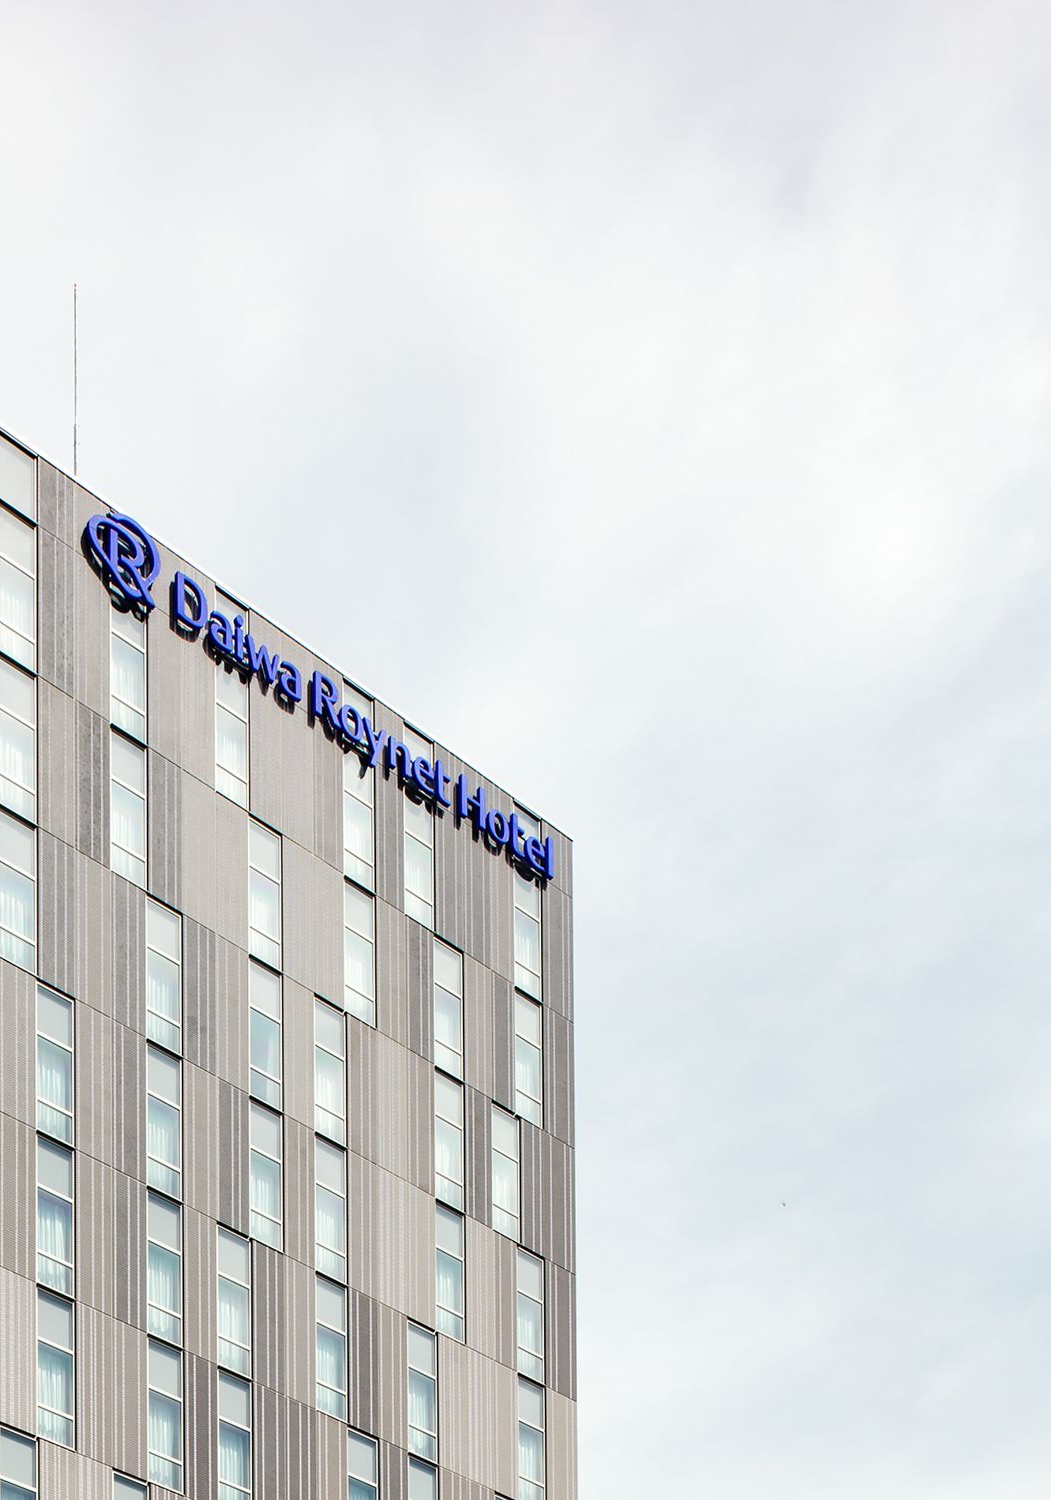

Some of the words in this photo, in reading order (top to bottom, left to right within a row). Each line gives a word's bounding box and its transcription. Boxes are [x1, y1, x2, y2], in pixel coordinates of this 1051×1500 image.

[173, 570, 303, 703] Daiwa
[312, 669, 451, 808] Roynet
[458, 772, 556, 881] Hotel
